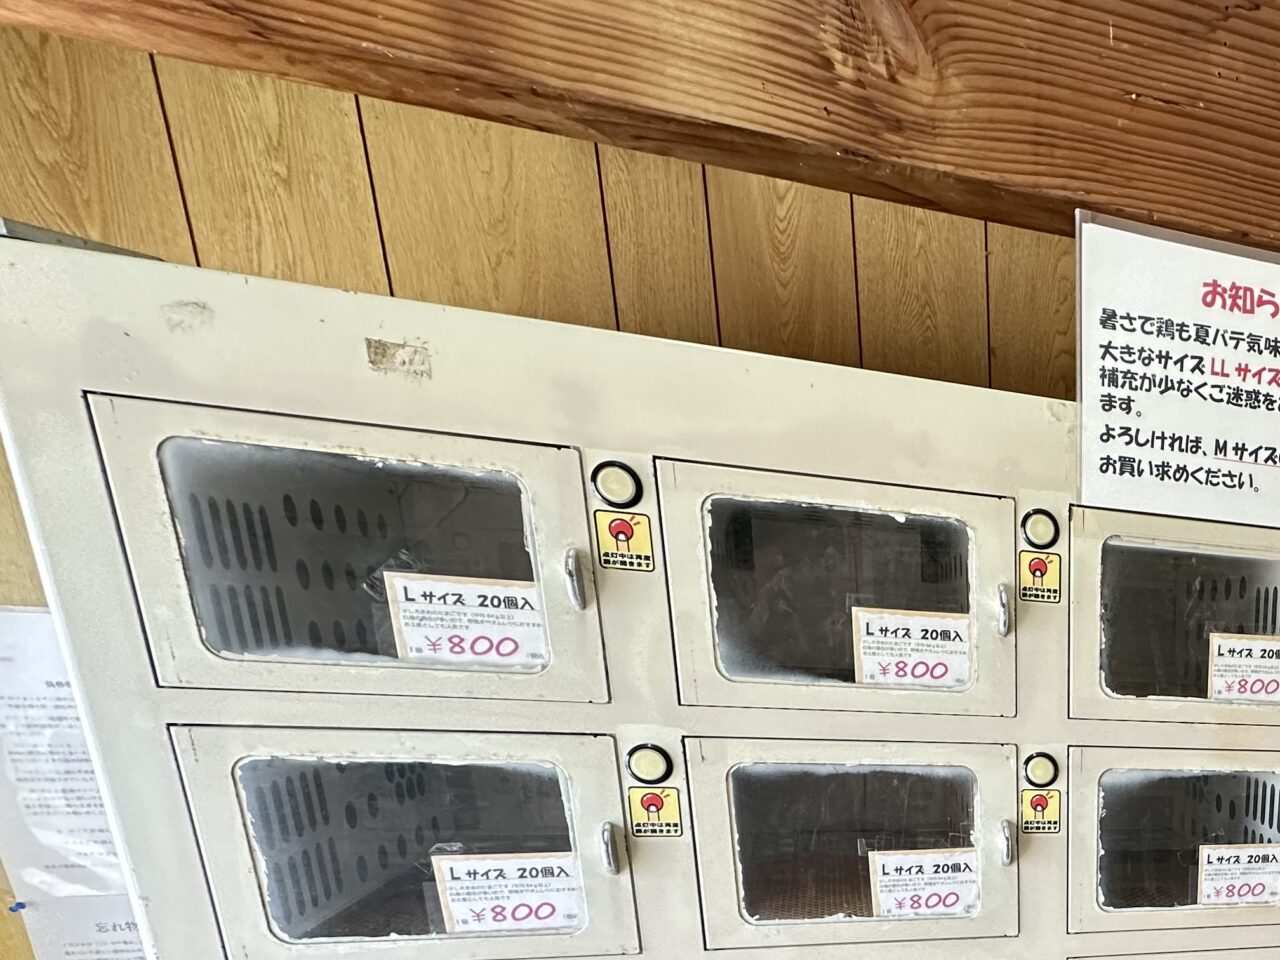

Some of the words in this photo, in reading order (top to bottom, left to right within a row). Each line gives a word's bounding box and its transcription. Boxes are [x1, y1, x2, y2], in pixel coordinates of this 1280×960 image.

[1099, 392, 1141, 417] ます。
[1099, 454, 1259, 493] お買い求めください。
[403, 587, 466, 606] Lサイズ
[477, 595, 535, 611] 20個入
[864, 622, 912, 640] Lサイズ
[919, 628, 964, 642] 20個入
[425, 634, 519, 657] ¥800
[1217, 644, 1253, 659] Lサイズ
[877, 660, 949, 681] ¥800
[1224, 678, 1280, 694] ¥800
[1206, 853, 1240, 865] Lサイズ
[1247, 853, 1278, 864] 20個入
[449, 867, 507, 881] Lサイズ
[517, 865, 570, 880] 20個入
[882, 863, 925, 876] Lサイズ
[932, 862, 973, 874] 20個入
[1213, 882, 1266, 898] ¥800
[894, 892, 960, 910] ¥800
[469, 902, 556, 923] ¥800
